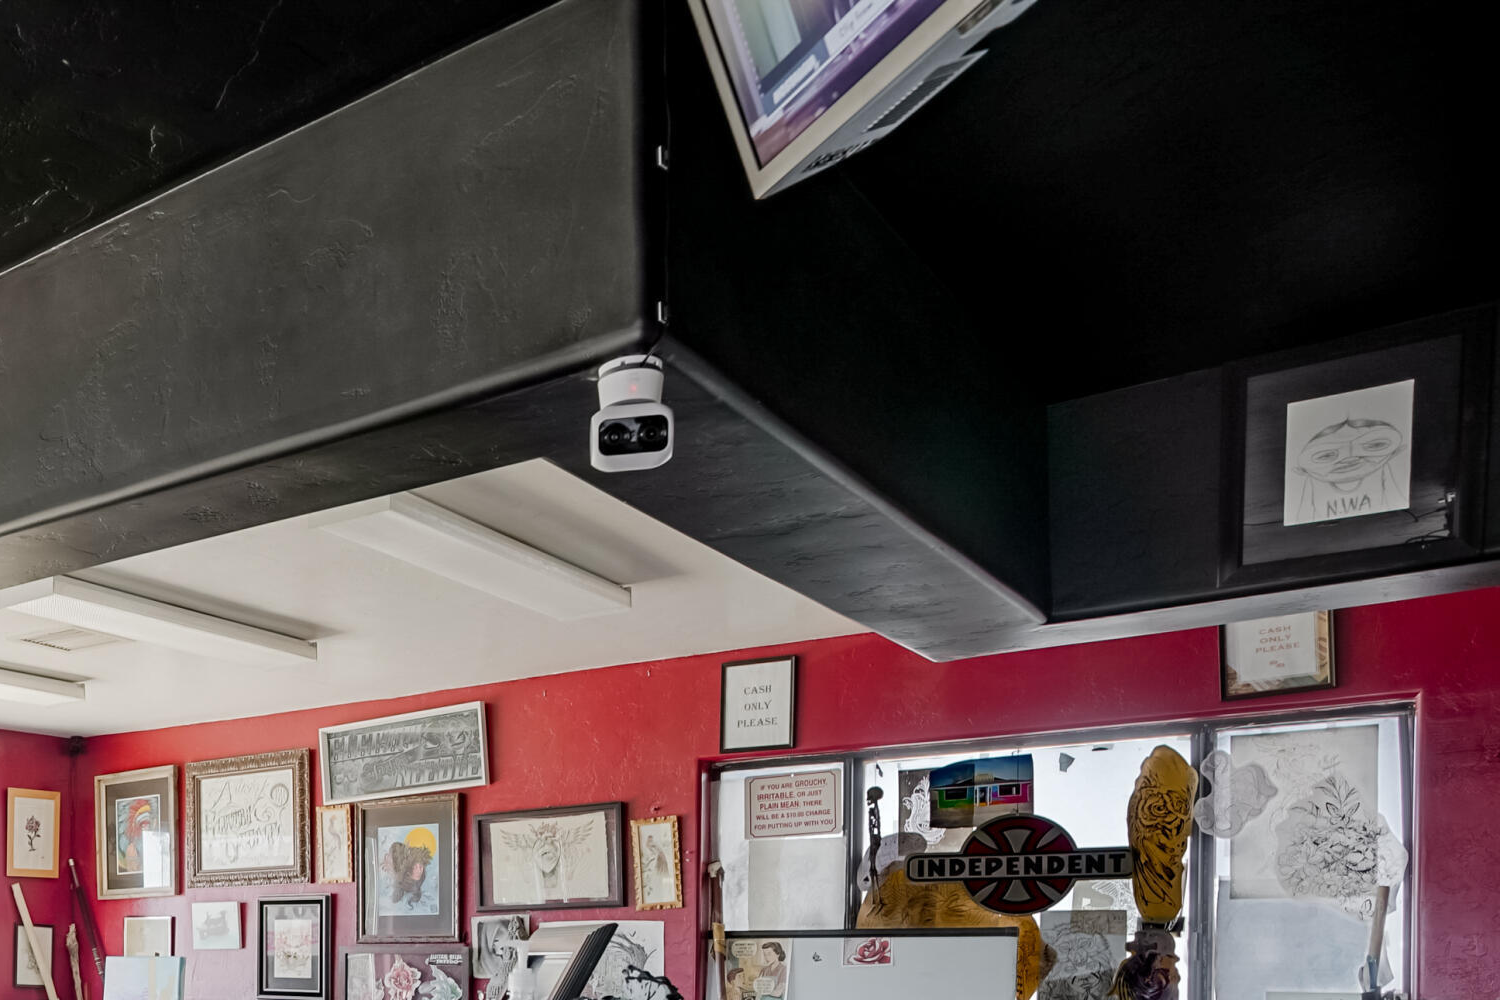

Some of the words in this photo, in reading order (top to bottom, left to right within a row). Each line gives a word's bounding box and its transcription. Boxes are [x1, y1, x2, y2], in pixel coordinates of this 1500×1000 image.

[1259, 625, 1291, 635] CASH
[1259, 634, 1291, 644] ONLY
[1255, 642, 1300, 654] PLEASE
[744, 684, 772, 695] CASH
[744, 700, 772, 711] ONLY
[737, 717, 778, 728] PLEASE
[807, 789, 822, 797] JUST
[759, 802, 779, 811] PLAIN
[803, 799, 823, 807] THERE
[805, 808, 831, 817] CHARGE
[767, 821, 793, 830] PUTTING
[804, 819, 819, 827] WITH
[820, 818, 834, 826] YOU
[917, 853, 1126, 878] INDEPENDENT
